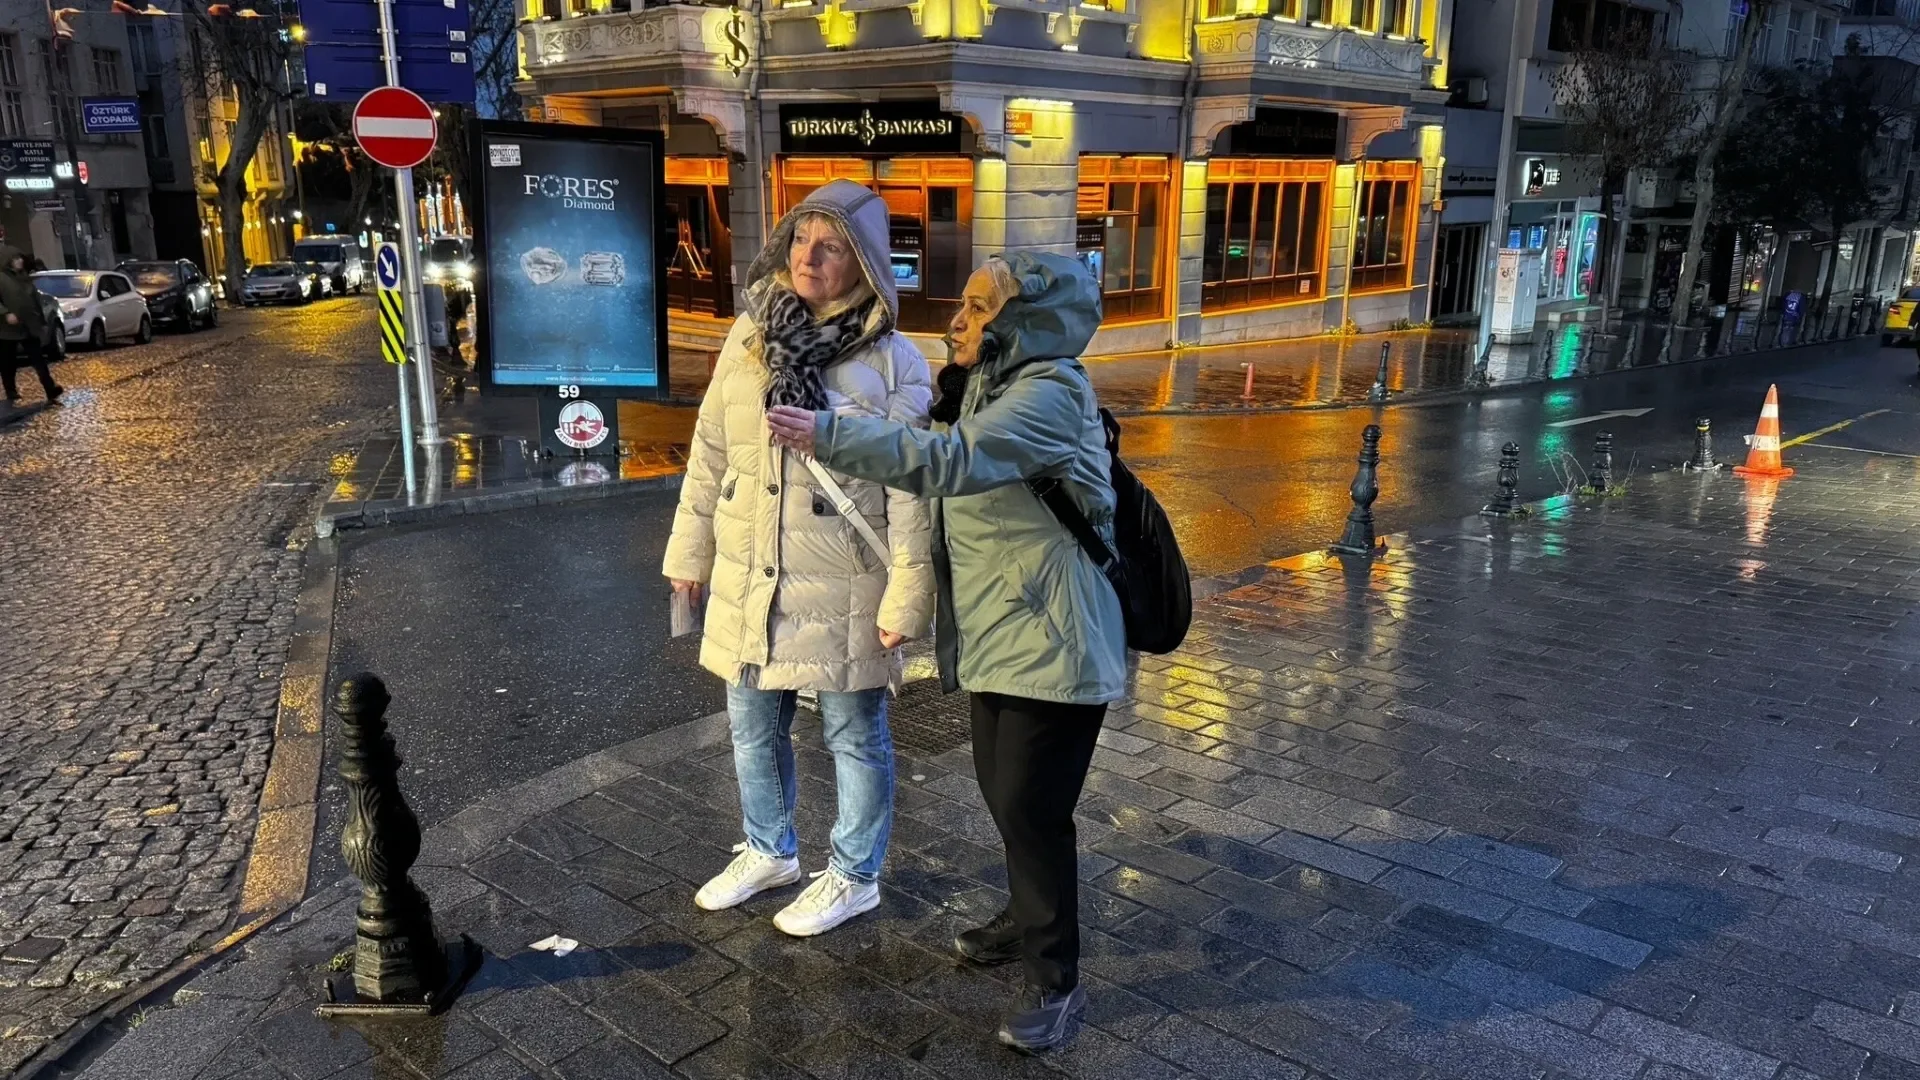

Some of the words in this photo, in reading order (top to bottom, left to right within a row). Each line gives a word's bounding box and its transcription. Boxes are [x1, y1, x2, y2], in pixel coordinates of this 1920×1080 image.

[92, 106, 130, 115] ÖZTÜRK
[90, 115, 135, 124] OTOPARK
[787, 117, 858, 136] TÜRKİYE
[877, 119, 953, 135] BANKASI
[563, 198, 615, 210] Diamond
[558, 384, 580, 399] 59
